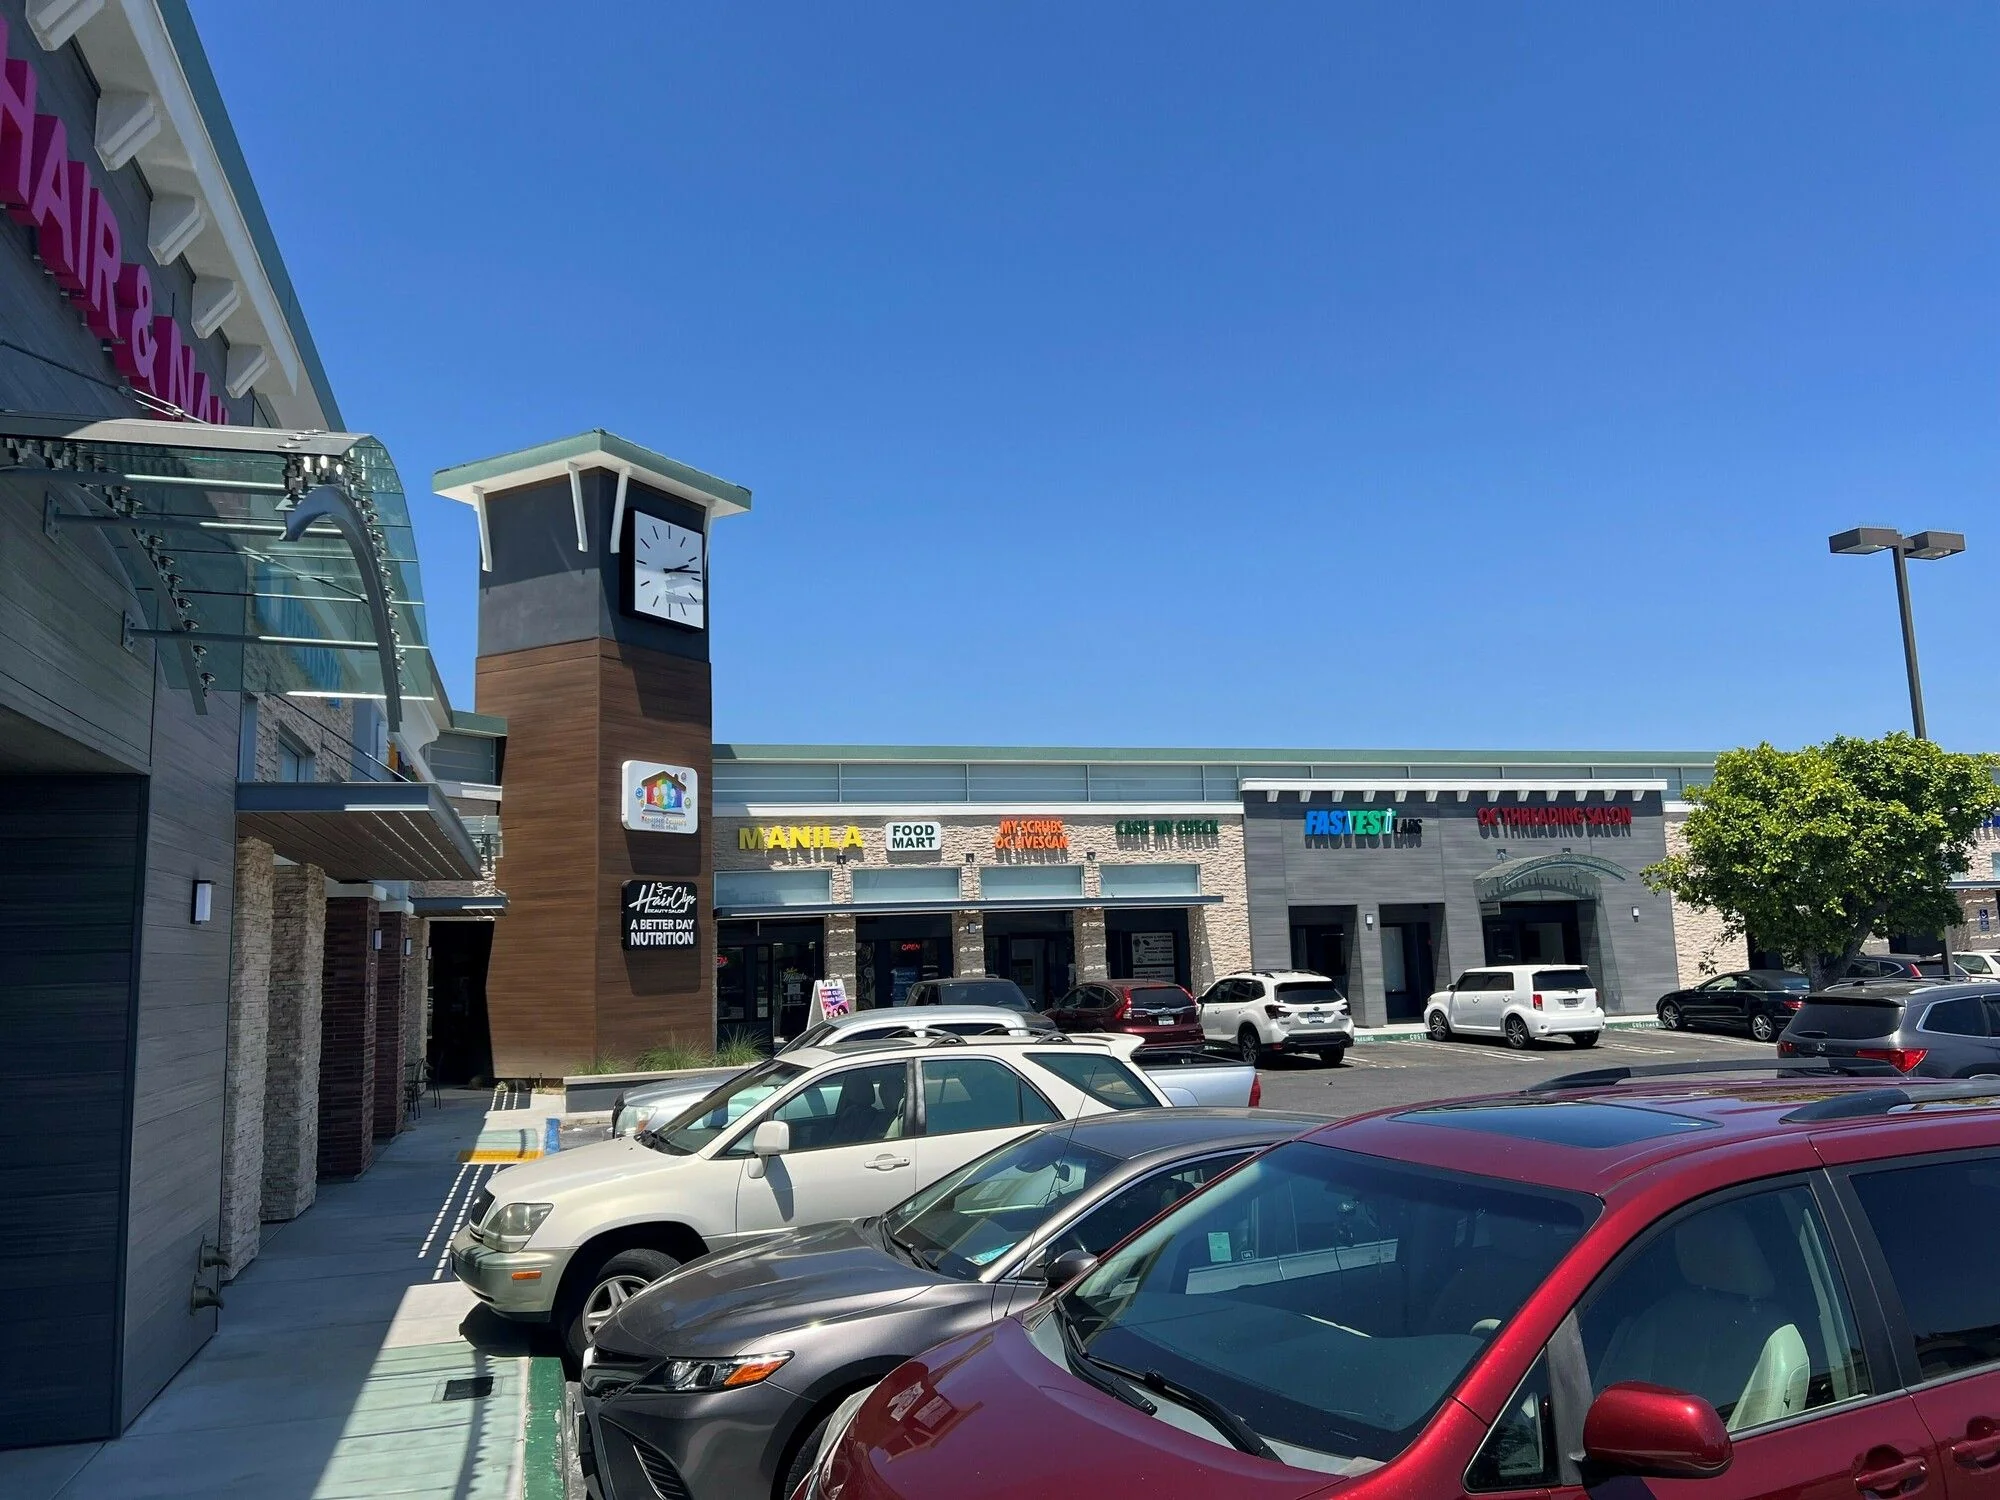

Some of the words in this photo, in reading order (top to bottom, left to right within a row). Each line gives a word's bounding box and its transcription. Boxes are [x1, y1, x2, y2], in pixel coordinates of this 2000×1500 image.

[0, 12, 121, 340] HAIR
[128, 263, 158, 397] &
[158, 316, 230, 425] NA
[1477, 807, 1499, 825] OC
[1501, 807, 1585, 825] THREADING
[1586, 807, 1632, 825] SALON
[892, 824, 935, 836] FOOD
[1000, 820, 1018, 835] MY
[1020, 820, 1064, 835] SCRUBS
[1115, 820, 1150, 835] CASH
[1153, 820, 1174, 835] MY
[1176, 820, 1219, 835] CHECK
[738, 824, 864, 850] MANILA
[892, 837, 936, 848] MART
[995, 835, 1013, 849] OC
[1014, 835, 1069, 849] LIVESCAN
[630, 919, 638, 930] A
[640, 919, 674, 930] BETTER
[676, 919, 695, 930] DAY
[630, 931, 694, 946] NUTRITION
[901, 943, 921, 951] OPEN
